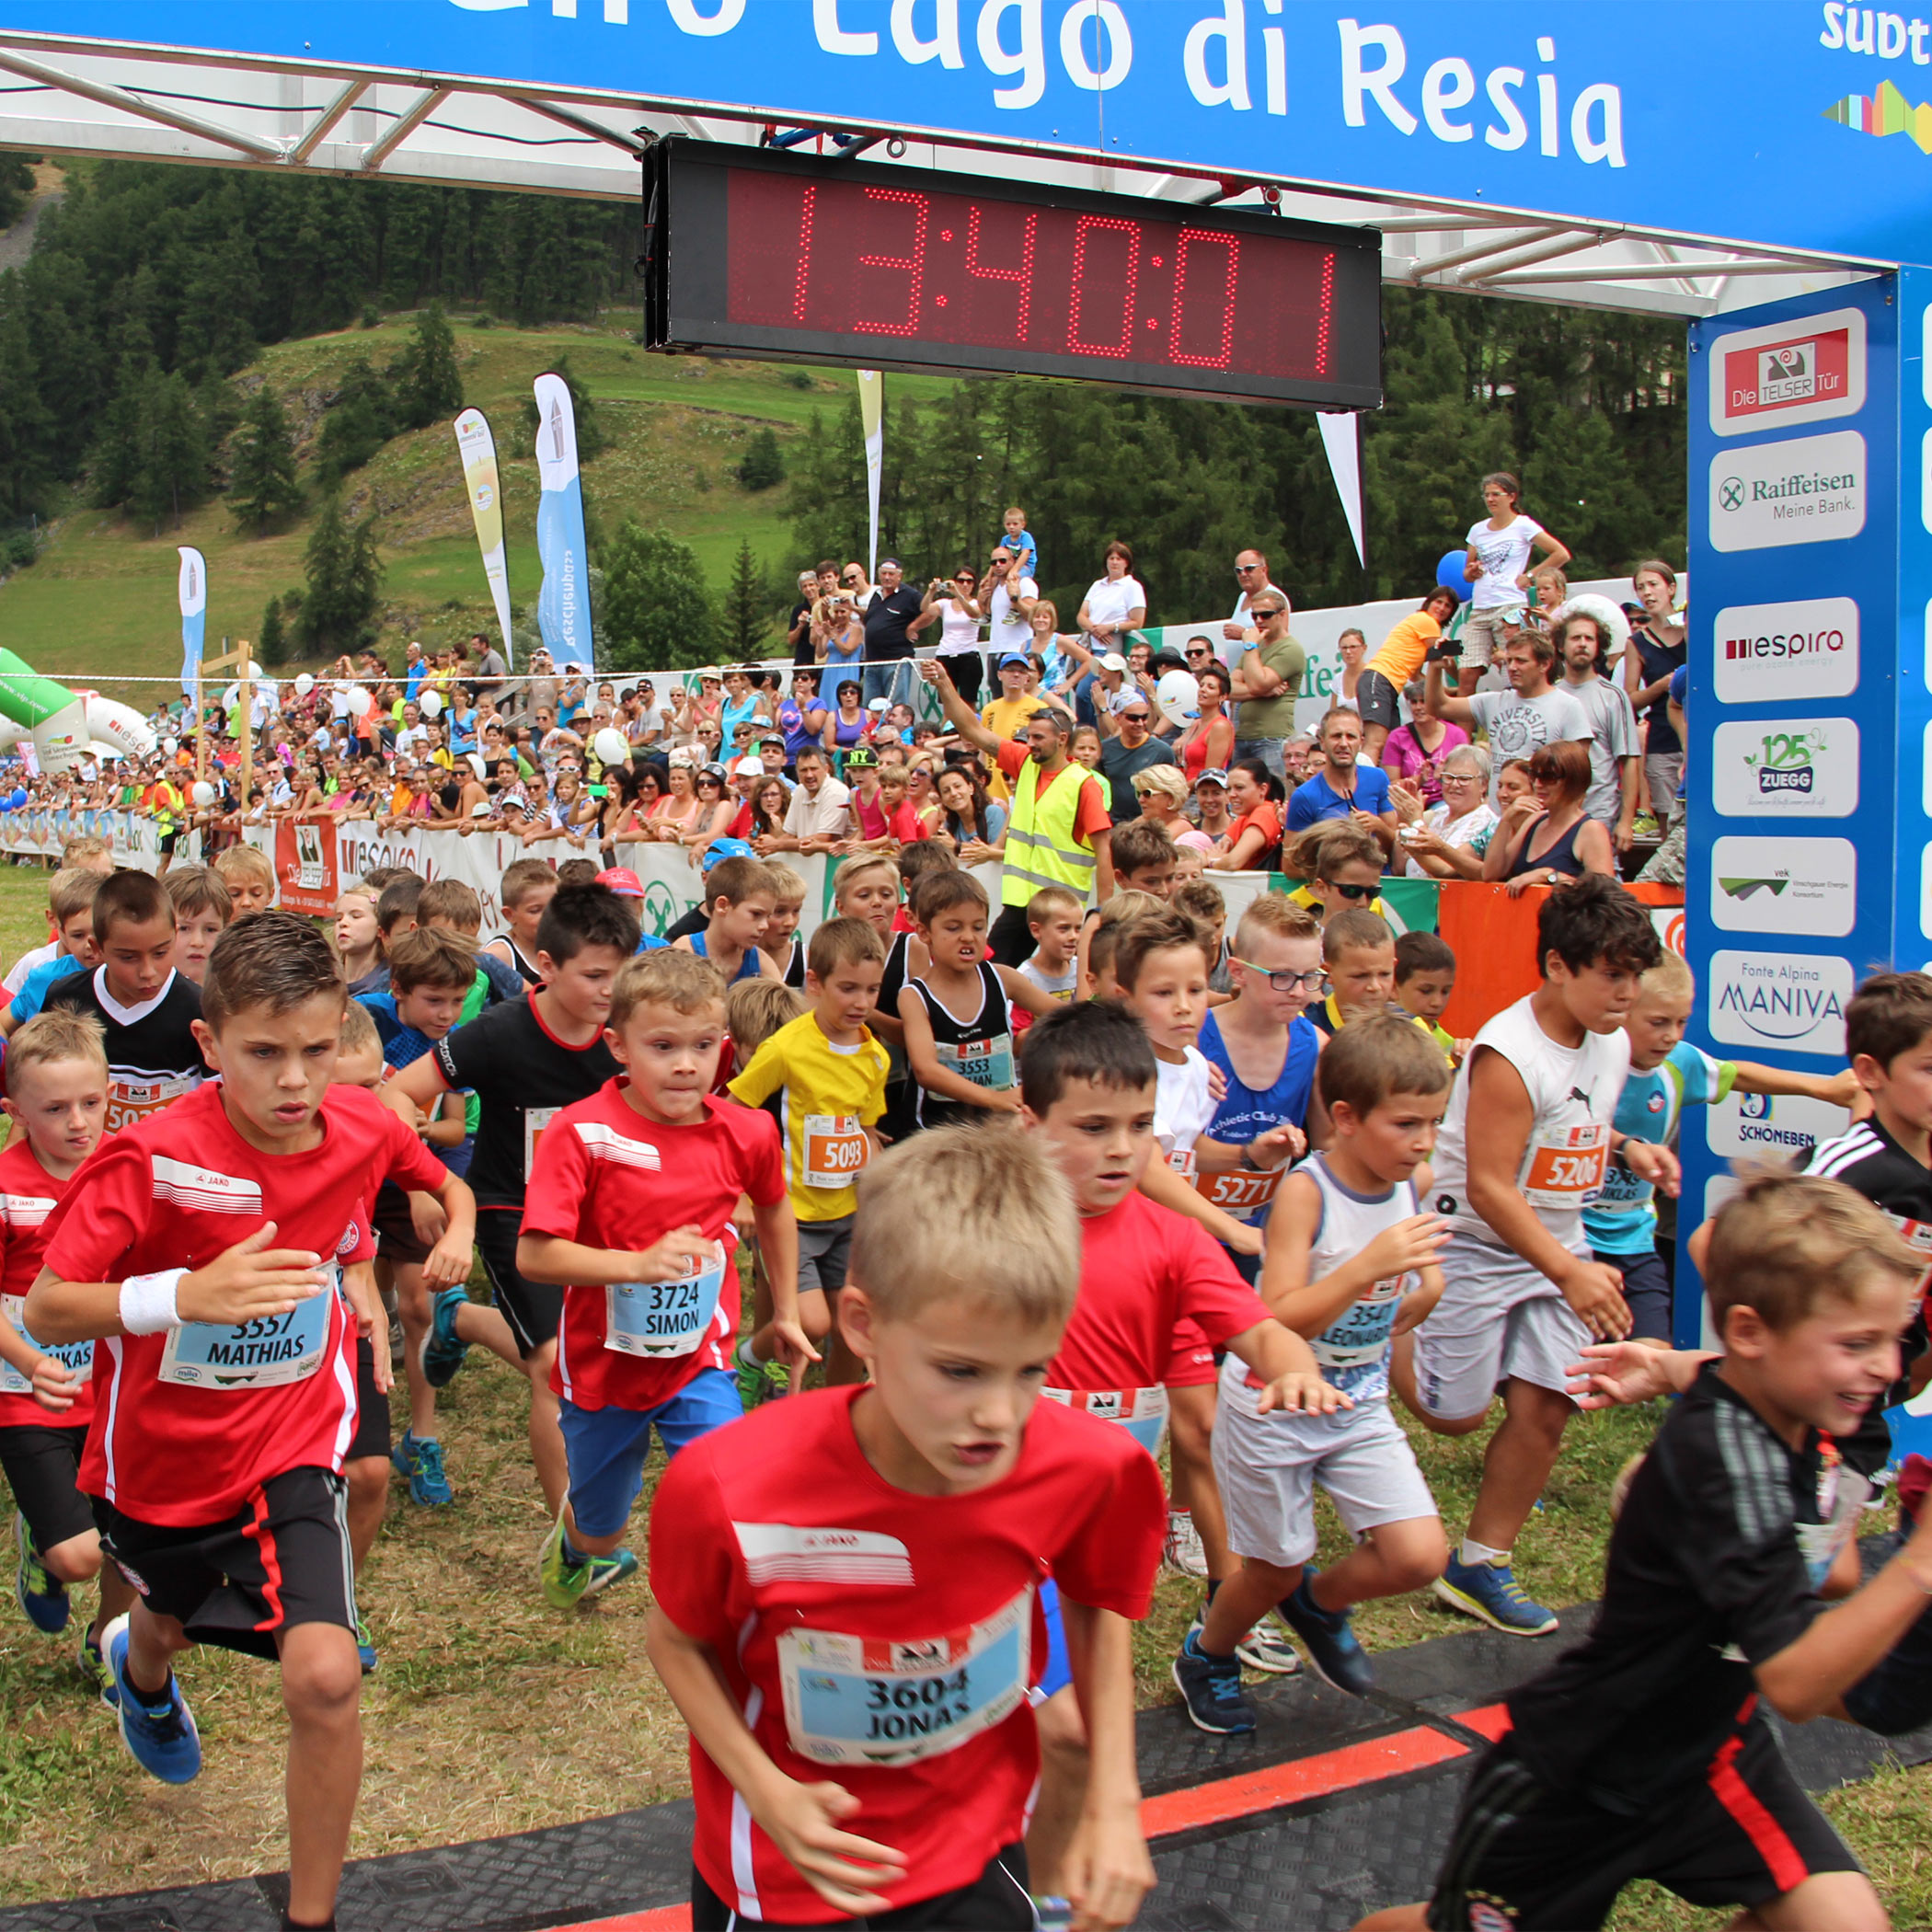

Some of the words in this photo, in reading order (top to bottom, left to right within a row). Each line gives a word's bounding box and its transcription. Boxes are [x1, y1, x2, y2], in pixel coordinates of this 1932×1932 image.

[1183, 0, 1288, 117] di
[1337, 18, 1627, 168] Resia
[791, 184, 1337, 375] 13:40:01
[1731, 389, 1757, 408] Die
[1761, 377, 1812, 402] TELSER
[1816, 372, 1841, 392] Tür
[1751, 472, 1856, 502] Raiffeisen
[1773, 502, 1814, 520] Meine
[1818, 496, 1857, 515] Bank.
[1489, 707, 1547, 746] UNIVERSITY
[849, 749, 868, 764] NY
[1761, 733, 1811, 767] 125
[1761, 773, 1811, 788] ZUEGG
[1774, 868, 1789, 877] vek
[1742, 963, 1774, 978] Fonte
[1778, 965, 1820, 983] Alpina
[1719, 983, 1844, 1020] MANIVA
[958, 1058, 990, 1075] 3553
[1739, 1122, 1815, 1148] SCHÖNEBEN
[823, 1140, 862, 1168] 5093
[208, 1177, 230, 1188] JAKO
[1546, 1154, 1600, 1187] 5206
[1210, 1175, 1274, 1203] 5271
[650, 1281, 699, 1310] 3724
[645, 1309, 700, 1335] SIMON
[207, 1334, 305, 1365] MATHIAS
[865, 1666, 971, 1711] 3604
